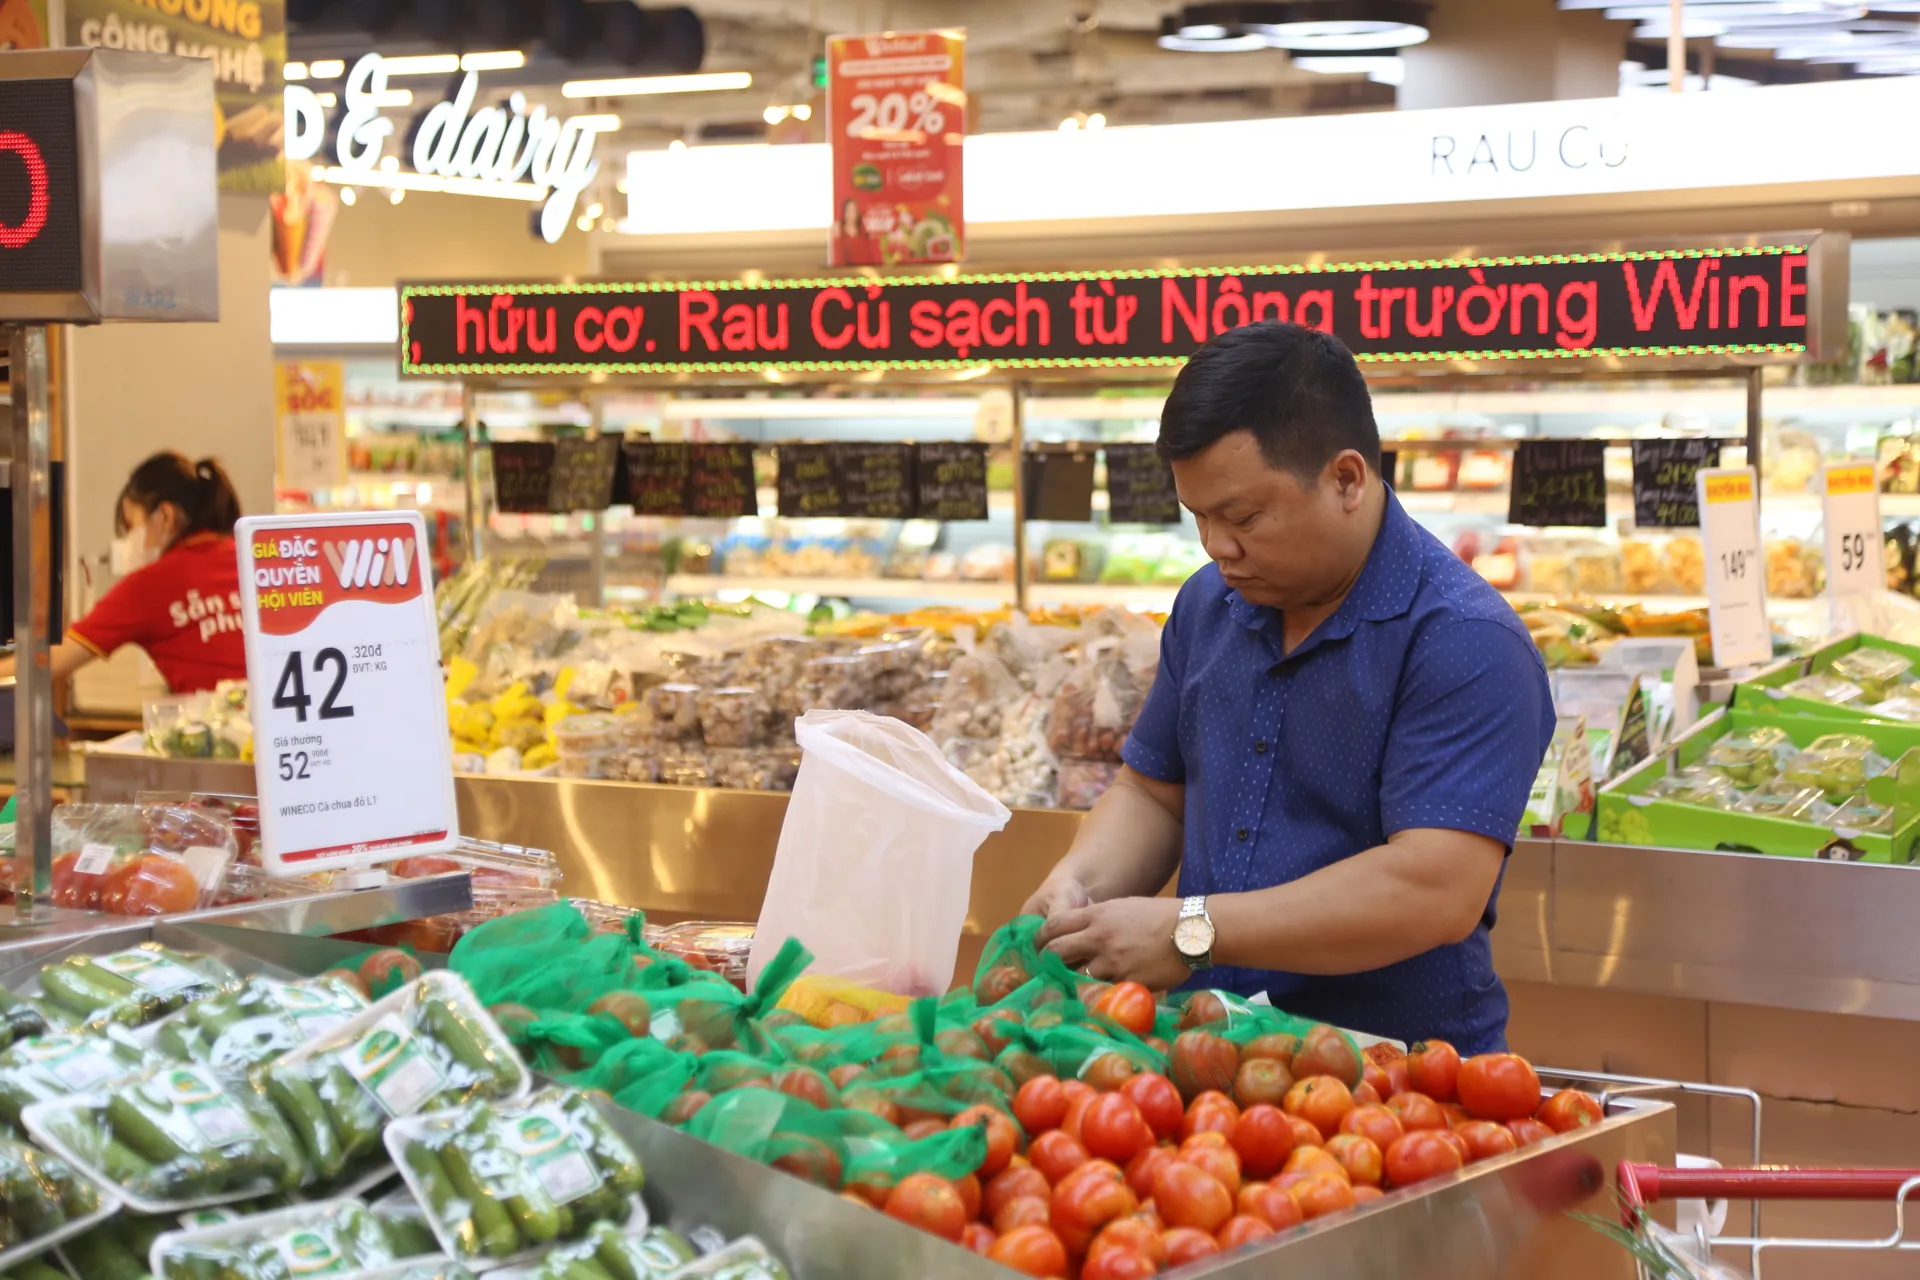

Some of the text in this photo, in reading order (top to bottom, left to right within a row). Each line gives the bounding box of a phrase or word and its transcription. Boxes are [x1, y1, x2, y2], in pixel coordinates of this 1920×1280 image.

[80, 12, 170, 53] CÔNG
[846, 91, 945, 138] 20%
[412, 69, 600, 244] dairy
[1431, 129, 1537, 176] RAU
[456, 293, 557, 355] hữu
[573, 303, 657, 354] cơ.
[678, 289, 789, 353] Rau
[810, 284, 892, 350] Củ
[908, 282, 1051, 358] sạch
[1068, 279, 1139, 345] từ
[1353, 267, 1599, 350] trường
[252, 538, 280, 560] GIÁ
[1720, 547, 1746, 582] 149
[1842, 532, 1865, 572] 59
[254, 558, 321, 588] QUYỀN
[257, 587, 324, 612] HỘI VIÊN
[272, 643, 383, 723] 42 .320đ
[375, 660, 388, 672] KG
[273, 732, 323, 749] Giá thường
[278, 750, 312, 782] 52
[279, 803, 316, 818] WINECO
[317, 800, 330, 813] Cà
[331, 798, 352, 811] chua
[366, 794, 377, 806] L1
